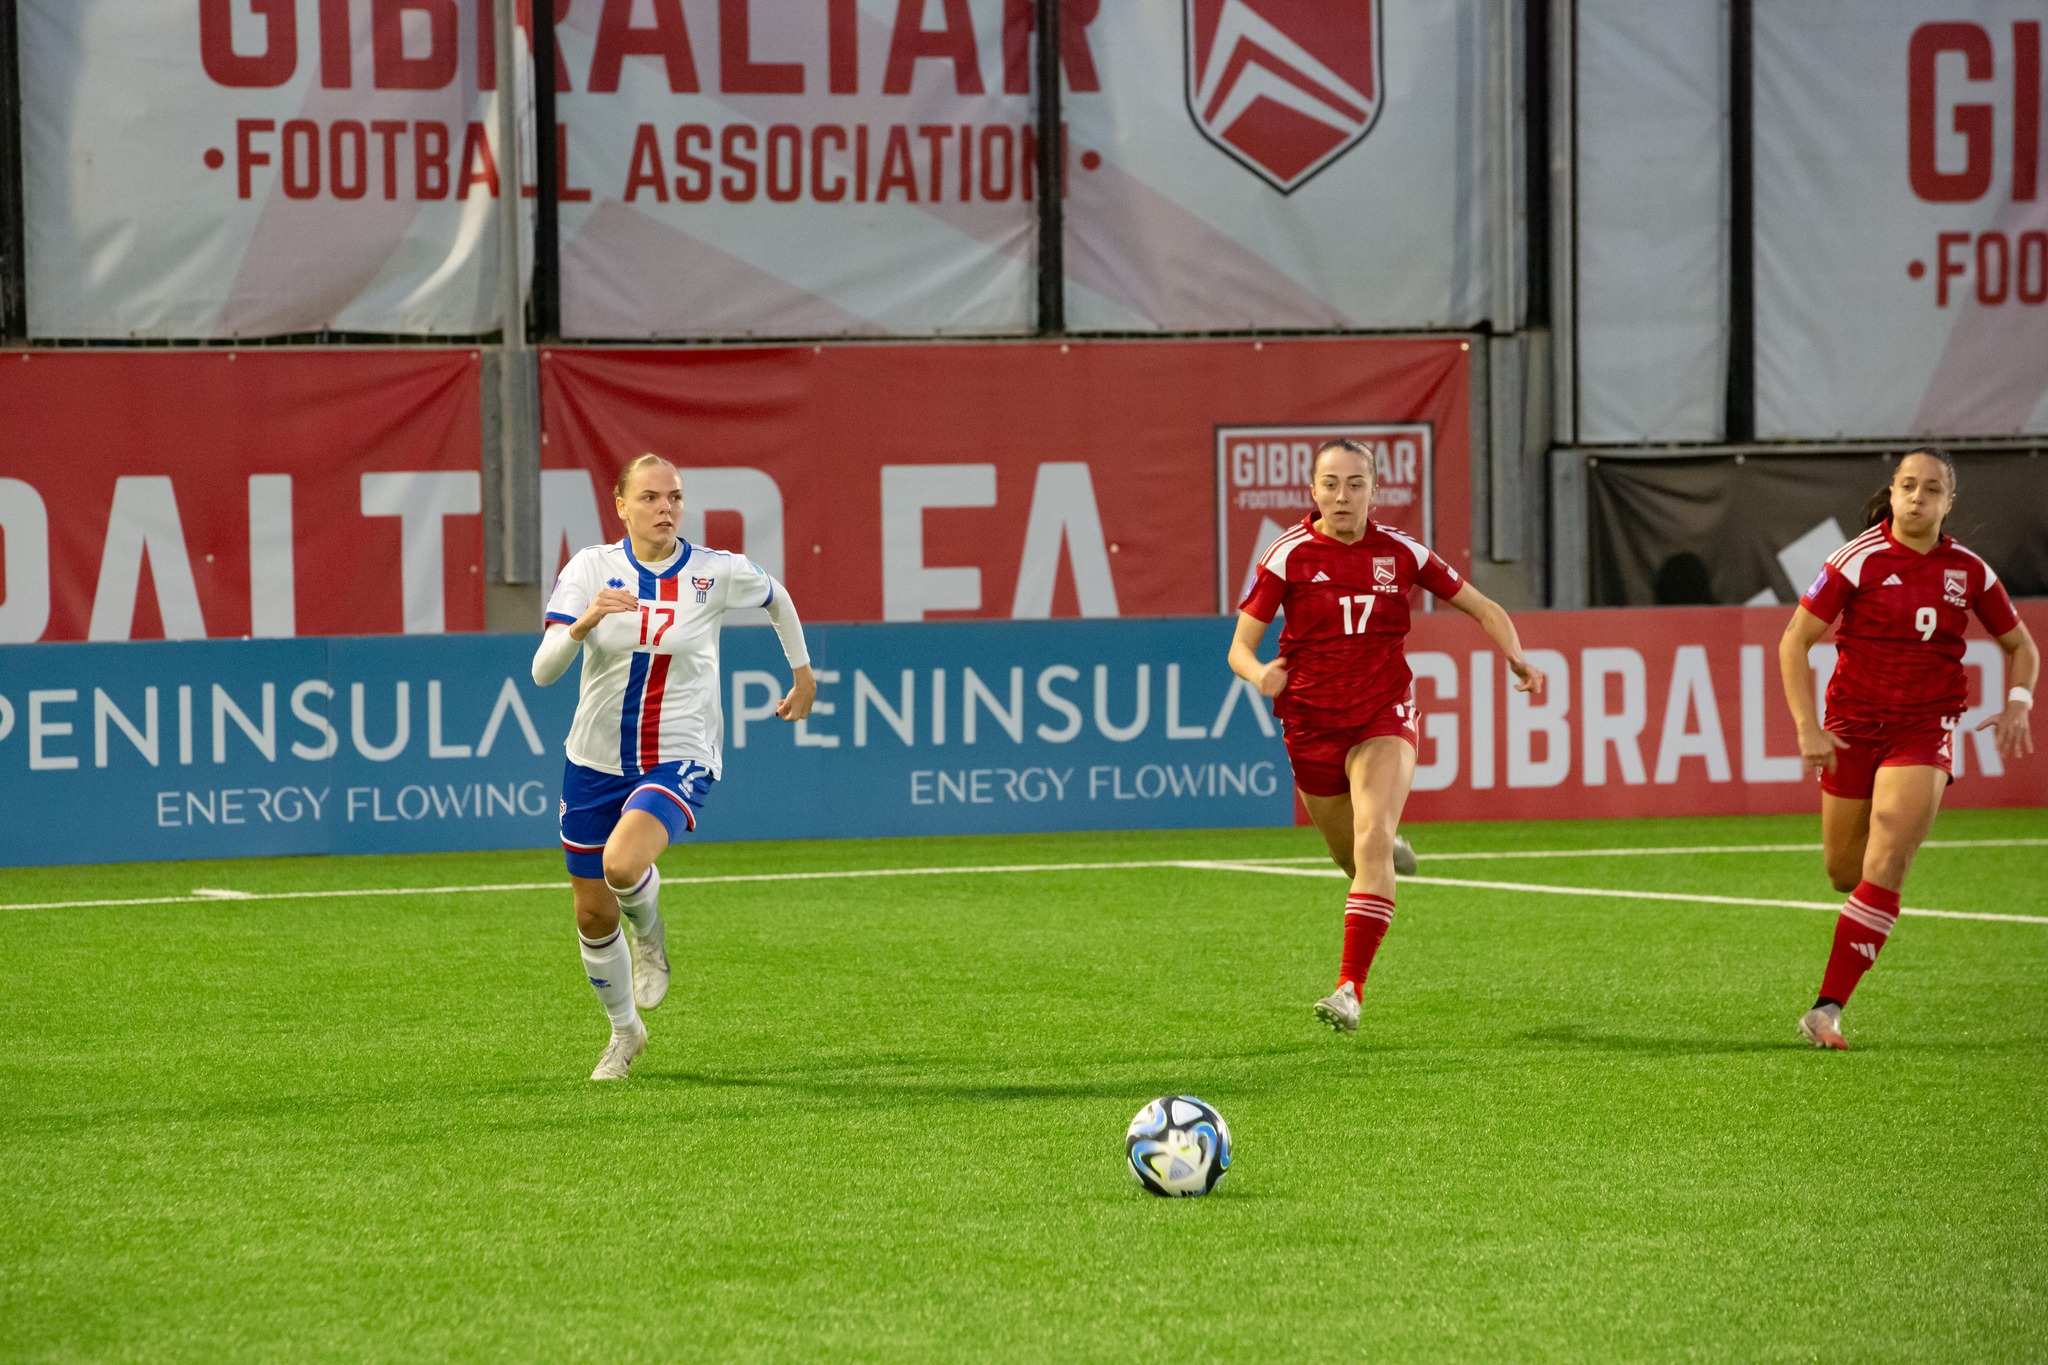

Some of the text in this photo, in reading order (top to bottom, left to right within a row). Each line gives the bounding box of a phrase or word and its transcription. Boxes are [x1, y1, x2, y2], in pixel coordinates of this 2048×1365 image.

[236, 118, 592, 203] FOOTBAL
[1232, 440, 1417, 488] GIBRAR
[637, 605, 676, 647] 17
[1338, 594, 1377, 636] 17
[1914, 606, 1938, 642] 9
[1404, 640, 2006, 791] GIBRALR
[156, 779, 549, 827] ENERGY FLOWING
[910, 760, 1279, 806] ENERGY FLOWING
